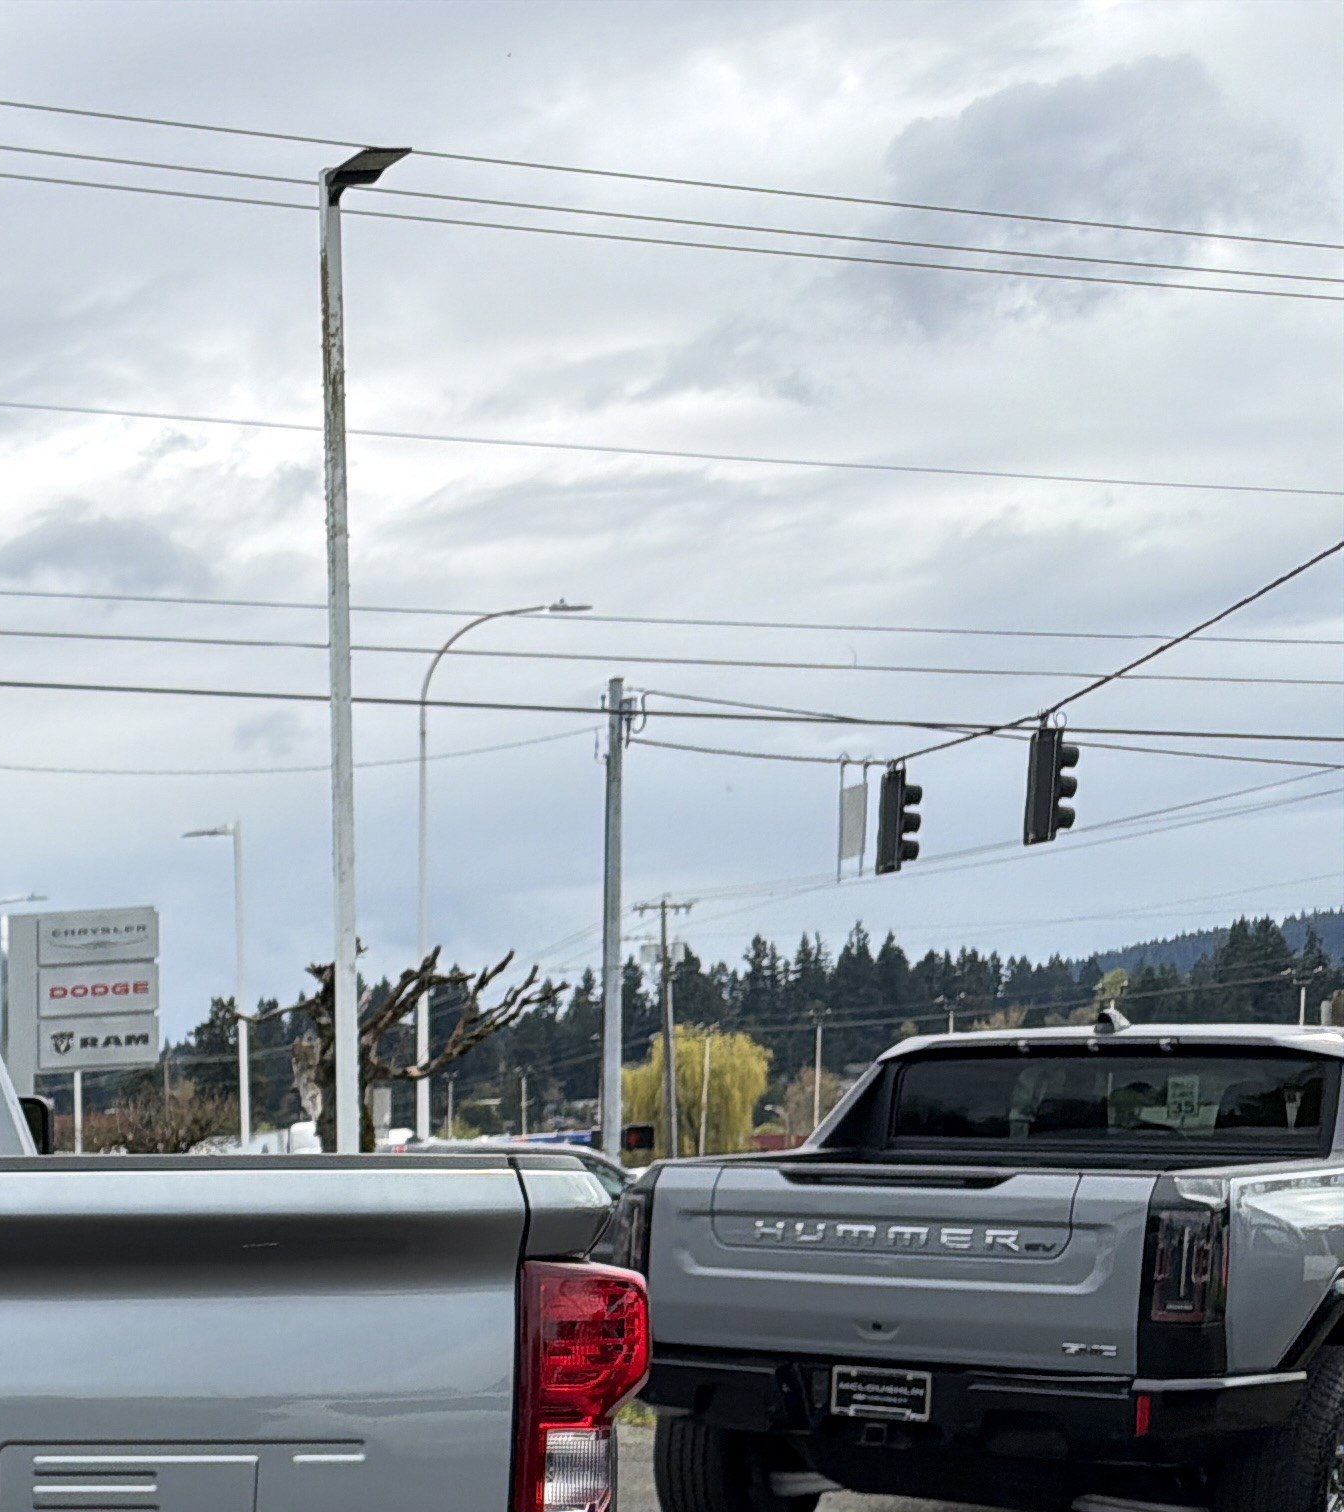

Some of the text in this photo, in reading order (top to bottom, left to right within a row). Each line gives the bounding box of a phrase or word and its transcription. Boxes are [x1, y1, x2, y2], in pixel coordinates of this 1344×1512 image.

[49, 981, 149, 1000] DODGE
[79, 1033, 149, 1049] RAM
[755, 1220, 1019, 1250] HUMMER
